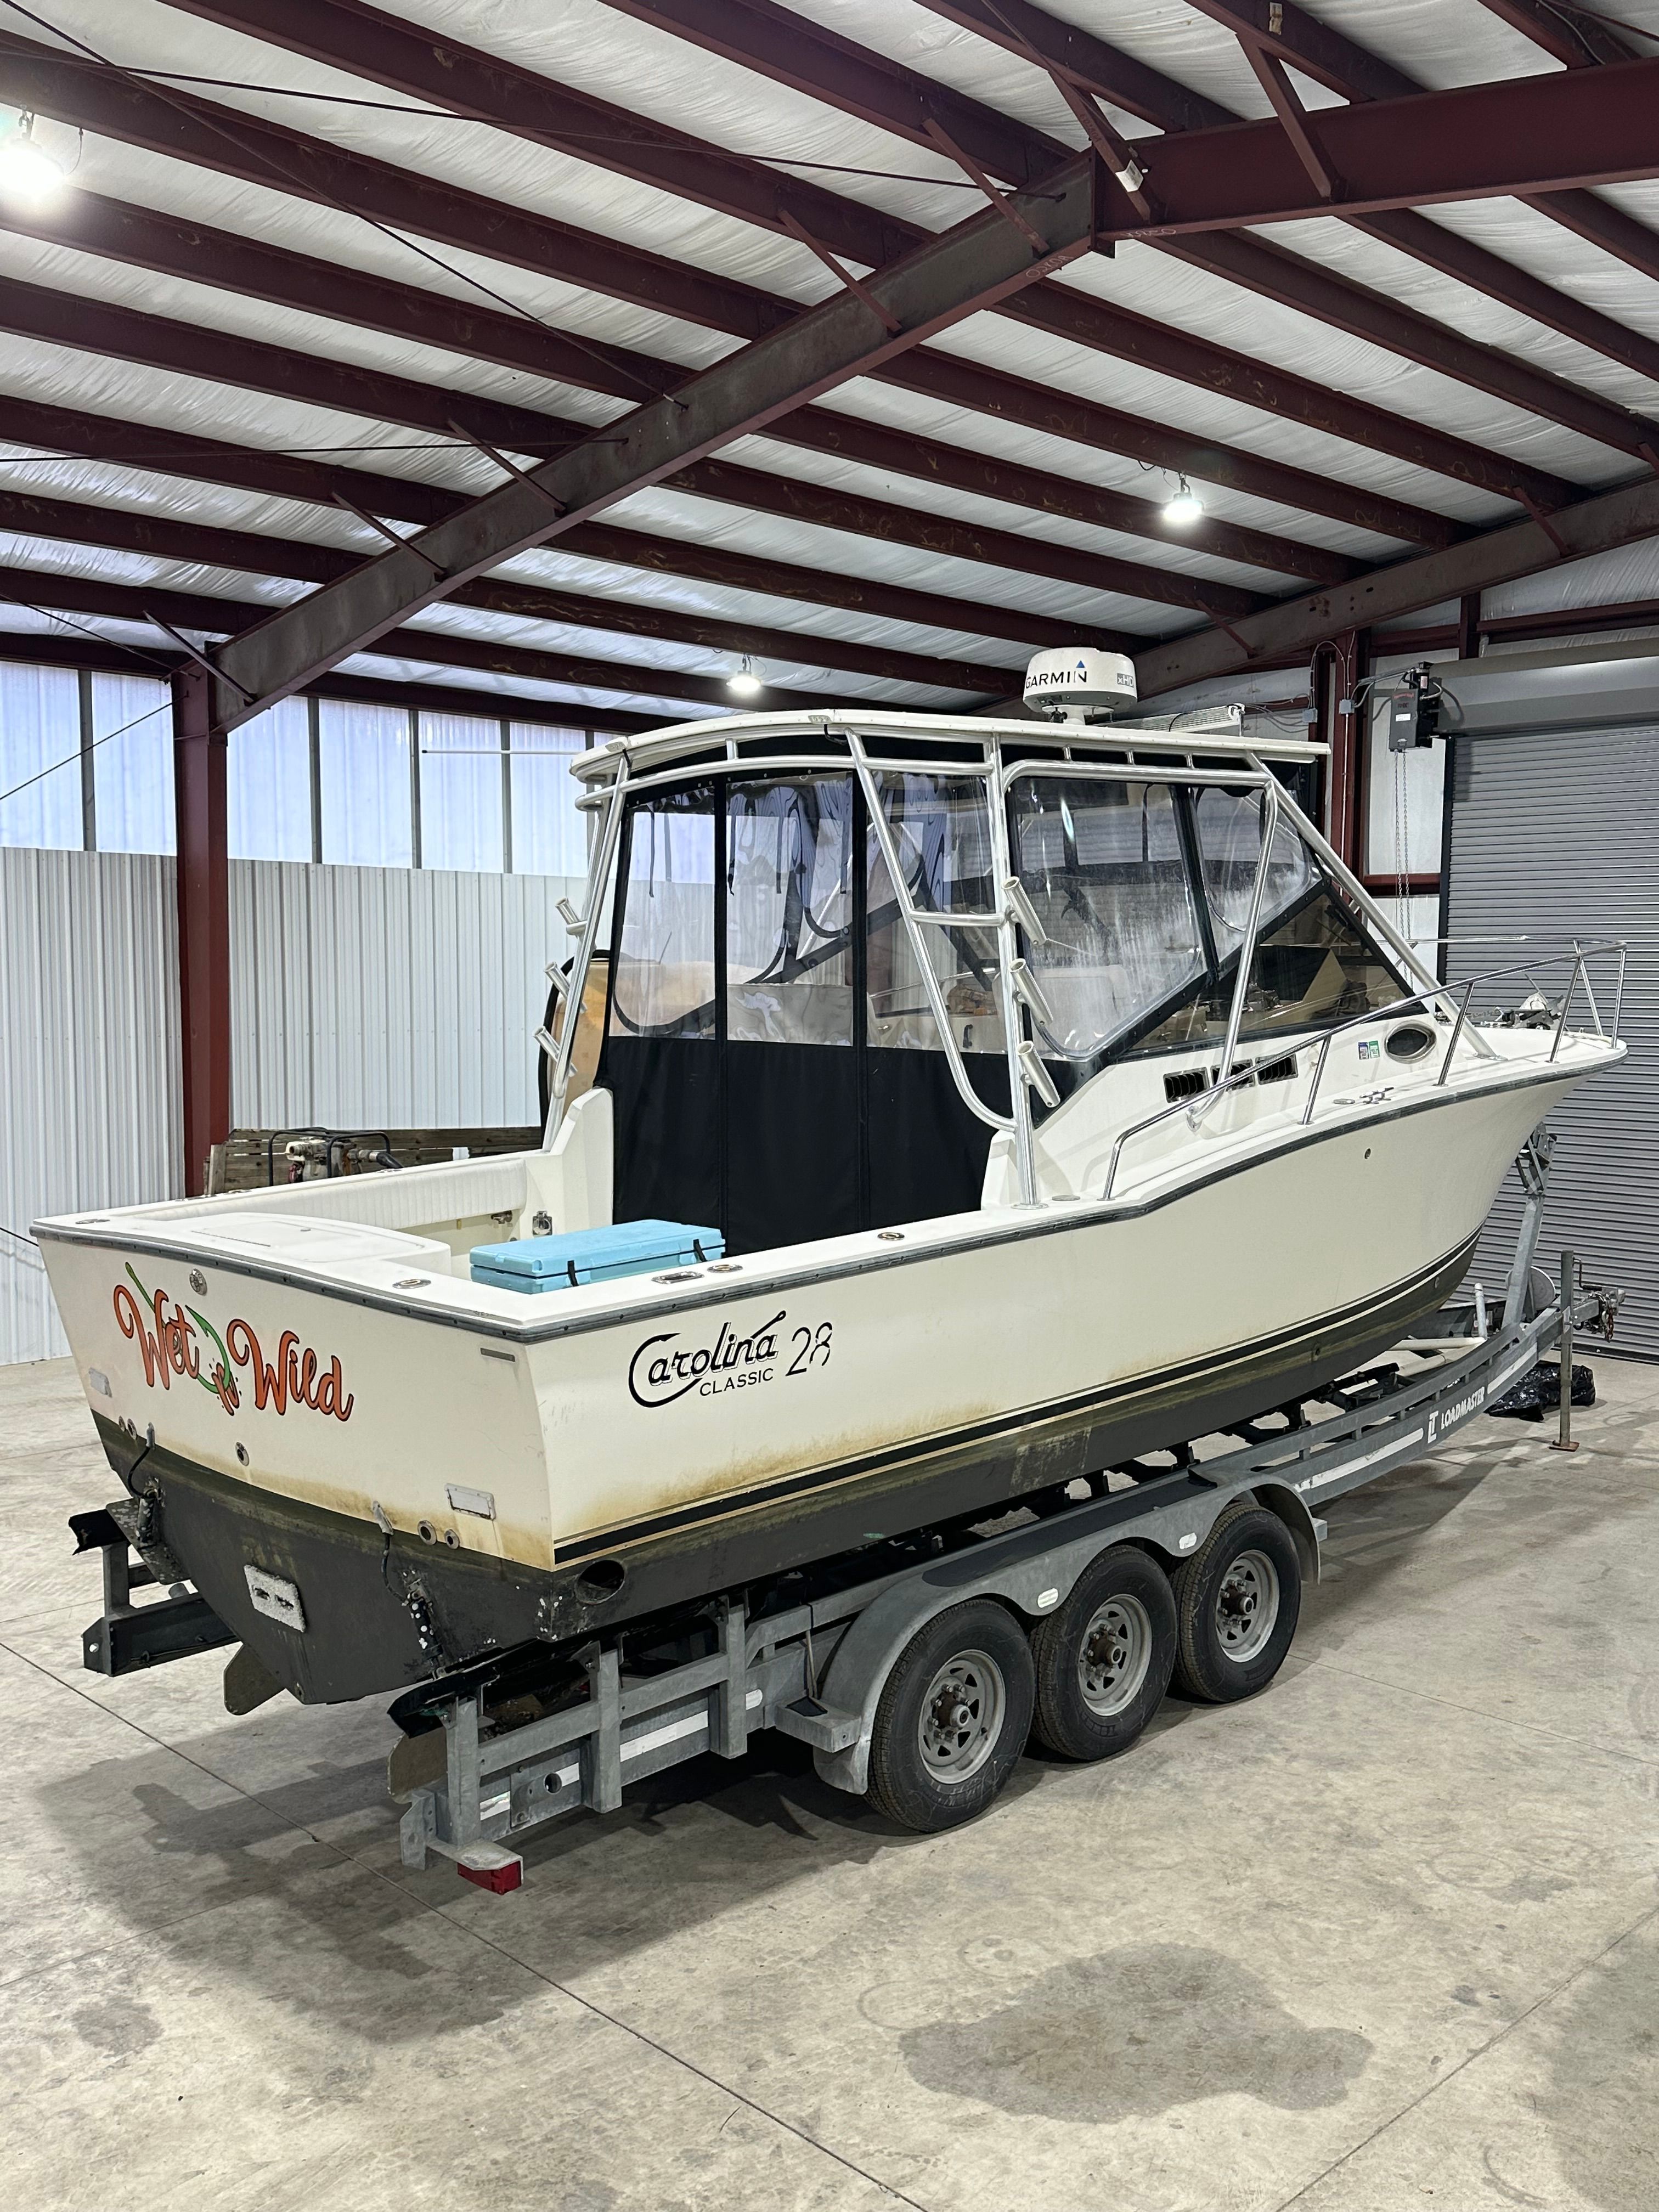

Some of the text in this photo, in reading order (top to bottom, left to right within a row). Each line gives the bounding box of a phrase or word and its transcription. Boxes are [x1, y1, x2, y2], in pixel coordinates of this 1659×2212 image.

[1026, 670, 1087, 689] GARMIN
[1117, 674, 1134, 687] xHD
[114, 1284, 199, 1390] Wet
[227, 1318, 354, 1422] Wild
[628, 1319, 833, 1408] Carolina 28
[699, 1368, 774, 1397] CLASSIC
[1441, 1386, 1485, 1430] LOADMASTER
